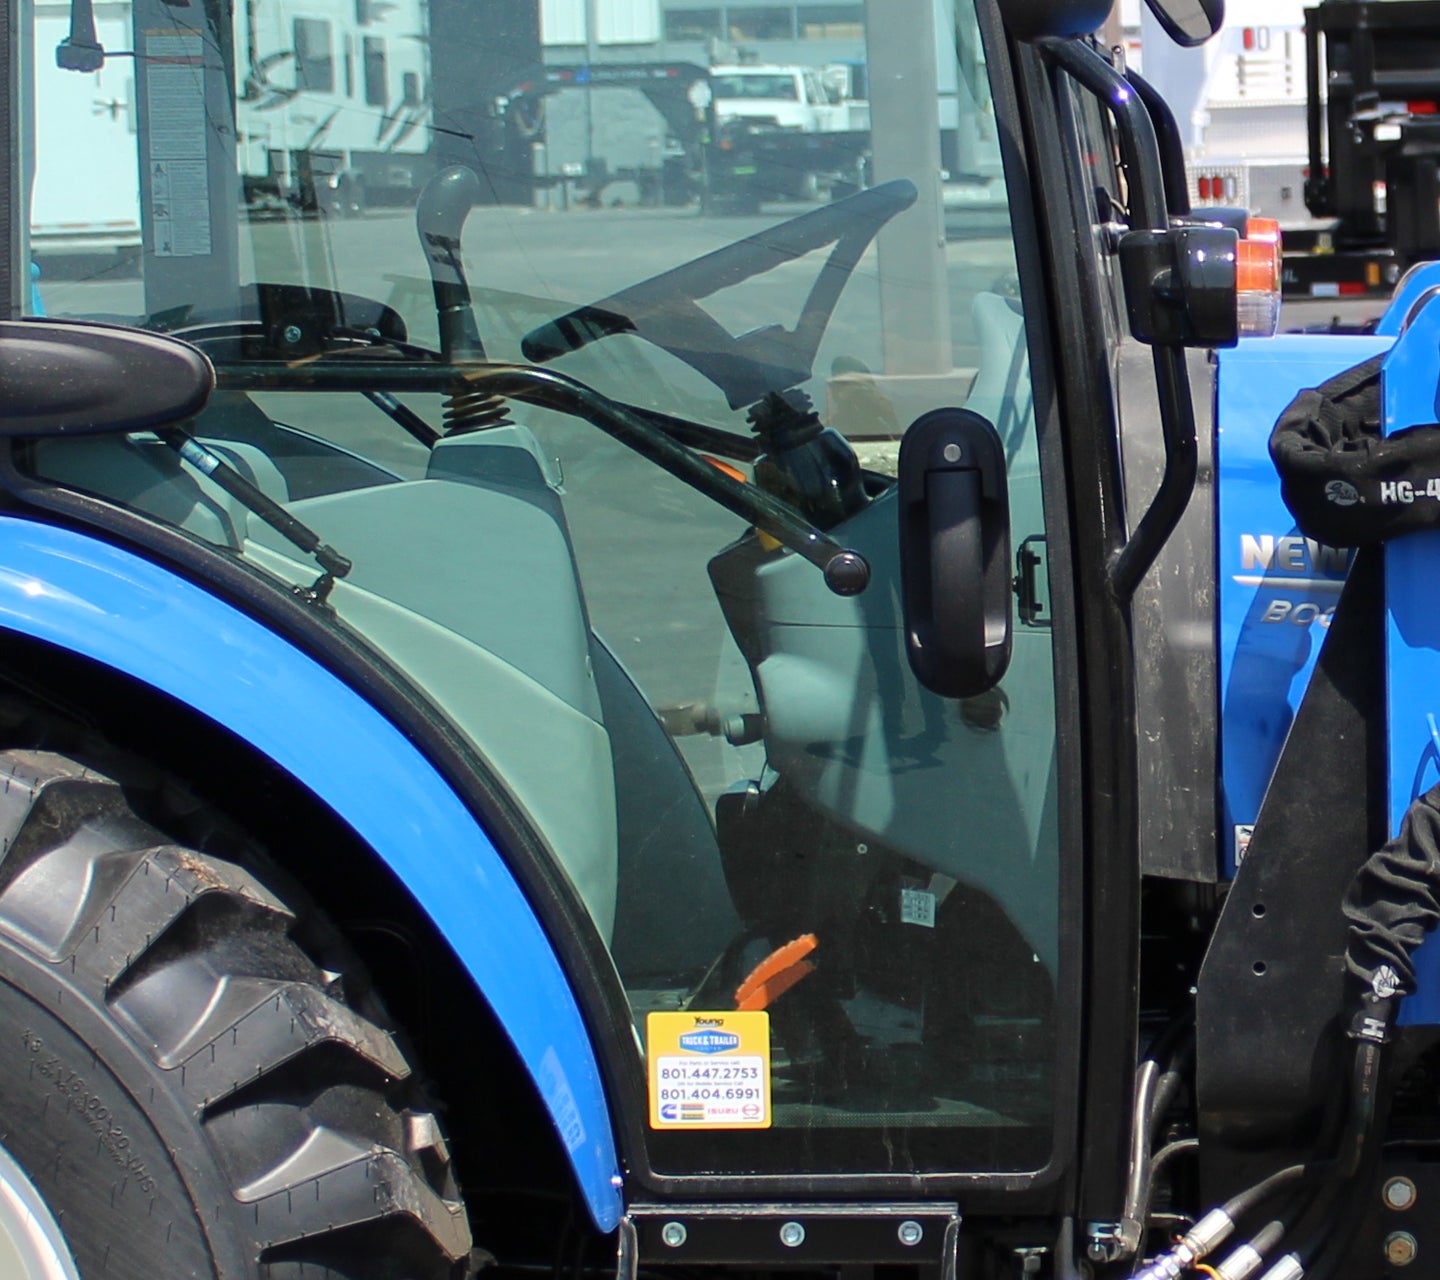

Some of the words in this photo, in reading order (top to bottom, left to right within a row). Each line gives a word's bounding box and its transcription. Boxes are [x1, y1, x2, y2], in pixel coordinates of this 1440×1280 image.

[1240, 533, 1349, 573] NEW
[661, 1068, 758, 1080] 801.447.2753
[661, 1089, 760, 1100] 801.404.6991
